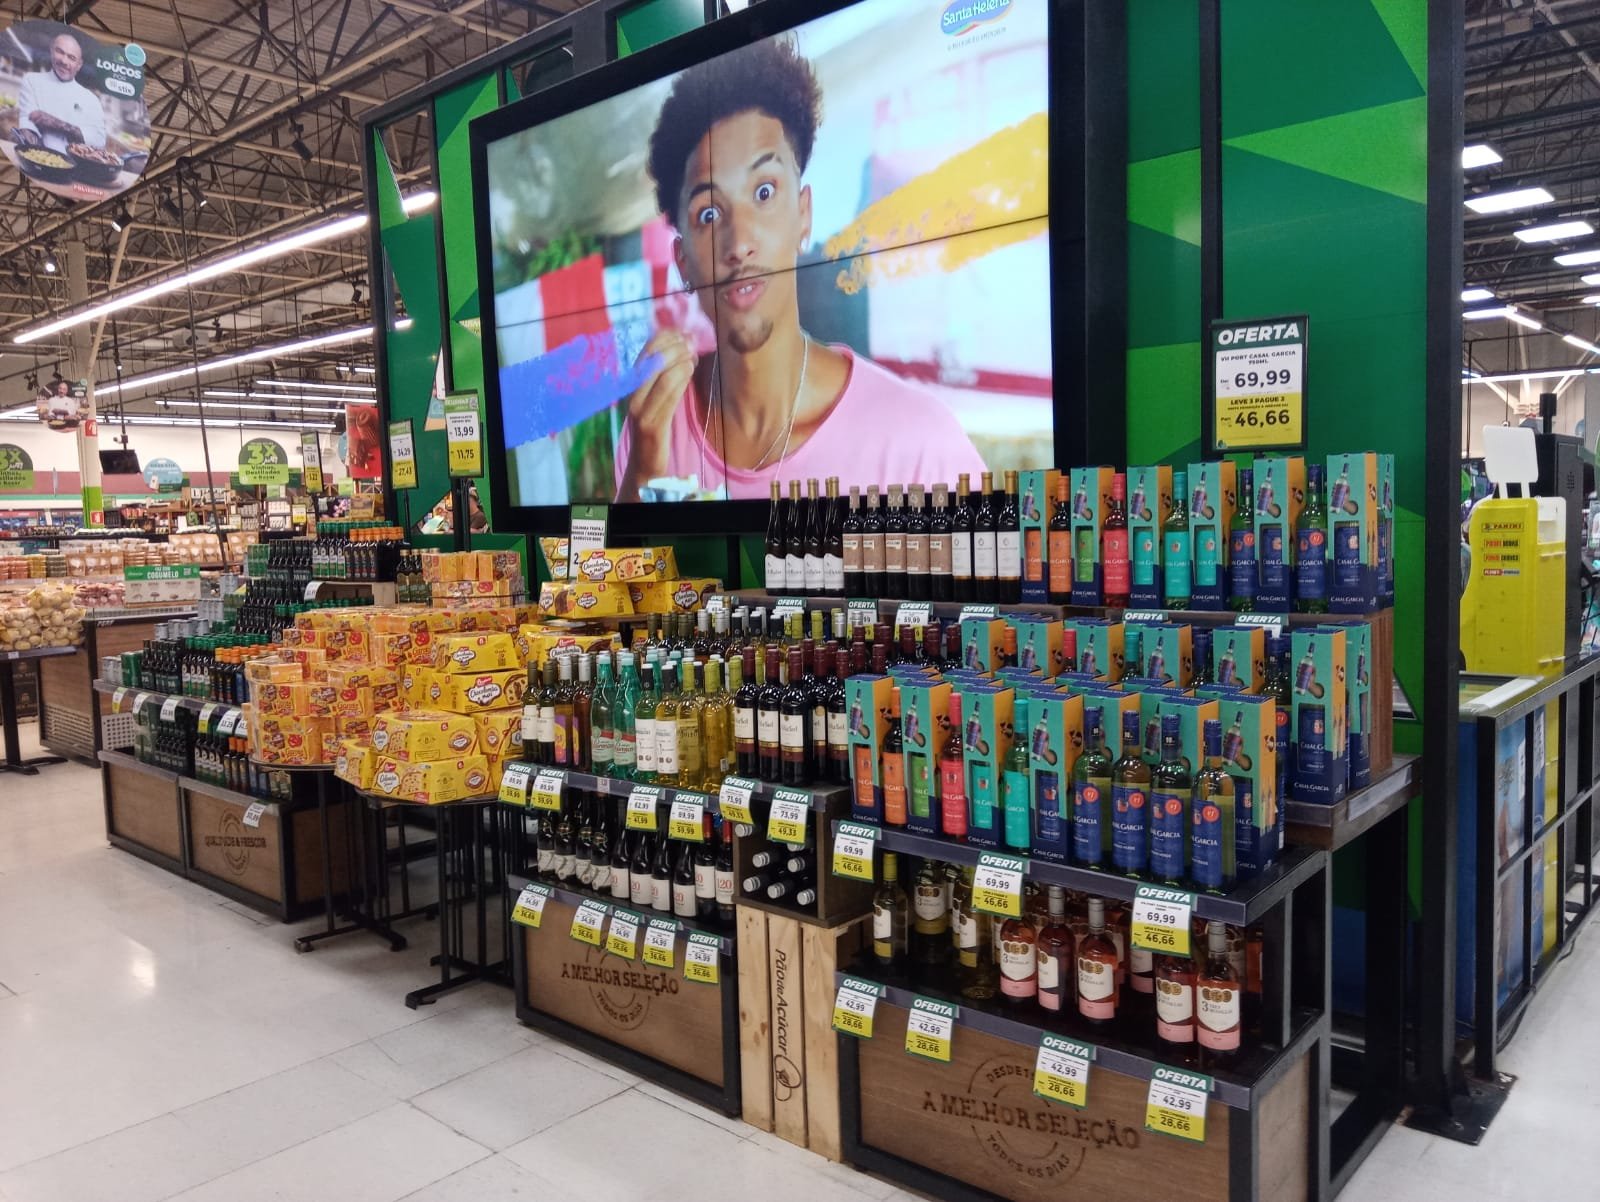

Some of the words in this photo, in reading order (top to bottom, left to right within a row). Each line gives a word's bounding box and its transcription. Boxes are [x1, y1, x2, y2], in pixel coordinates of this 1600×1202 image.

[96, 58, 142, 79] LOUCOS
[1218, 323, 1300, 345] OFERTA
[1234, 369, 1291, 388] 69,99
[1254, 396, 1279, 404] PAGUE
[1235, 410, 1290, 428] 46,66
[454, 427, 474, 437] 13,99
[456, 449, 475, 459] 11,75
[147, 571, 179, 579] COGUMELO
[849, 601, 876, 609] OFERTA
[900, 602, 930, 610] OFERTA
[962, 605, 995, 614] OFERTA
[1124, 612, 1163, 621] OFERTA
[1238, 615, 1282, 624] OFERTA
[509, 764, 531, 774] OFERTA
[540, 769, 565, 778] OFERTA
[725, 777, 755, 789] OFERTA
[633, 786, 660, 795] OFERTA
[775, 790, 809, 803] OFERTA
[675, 794, 704, 804] OFERTA
[1077, 816, 1098, 825] GARCIA
[1121, 823, 1144, 831] GARCIA
[840, 823, 875, 838] OFERTA
[1156, 830, 1181, 839] GARCIA
[1195, 837, 1218, 846] GARCIA
[981, 855, 1023, 871] OFERTA
[526, 883, 549, 896] OFERTA
[718, 879, 733, 890] 120
[985, 877, 1010, 890] 69,99
[1138, 887, 1190, 903] OFERTA
[583, 899, 608, 912] OFERTA
[983, 896, 1009, 909] 46,66
[614, 910, 640, 925] OFERTA
[1147, 911, 1176, 924] 69,99
[650, 919, 677, 932] OFERTA
[690, 934, 720, 946] OFERTA
[1145, 933, 1175, 946] 46,66
[561, 963, 572, 978] A
[572, 963, 622, 987] MELHOR
[623, 971, 679, 996] SELEÇÃO
[843, 978, 879, 996] OFERTA
[845, 999, 865, 1012] 42,99
[914, 999, 953, 1017] OFERTA
[1201, 1000, 1209, 1012] 3
[918, 1022, 941, 1035] 42,99
[916, 1040, 940, 1053] 28,66
[1043, 1036, 1089, 1058] OFERTA
[1051, 1062, 1077, 1077] 42,99
[1154, 1068, 1207, 1090] OFERTA
[1048, 1082, 1075, 1097] 28,66
[1163, 1095, 1192, 1110] 42,99
[923, 1092, 937, 1113] A
[940, 1092, 1032, 1132] MELHOR
[1035, 1111, 1141, 1149] SELEÇÃO
[1160, 1116, 1190, 1131] 28,66
